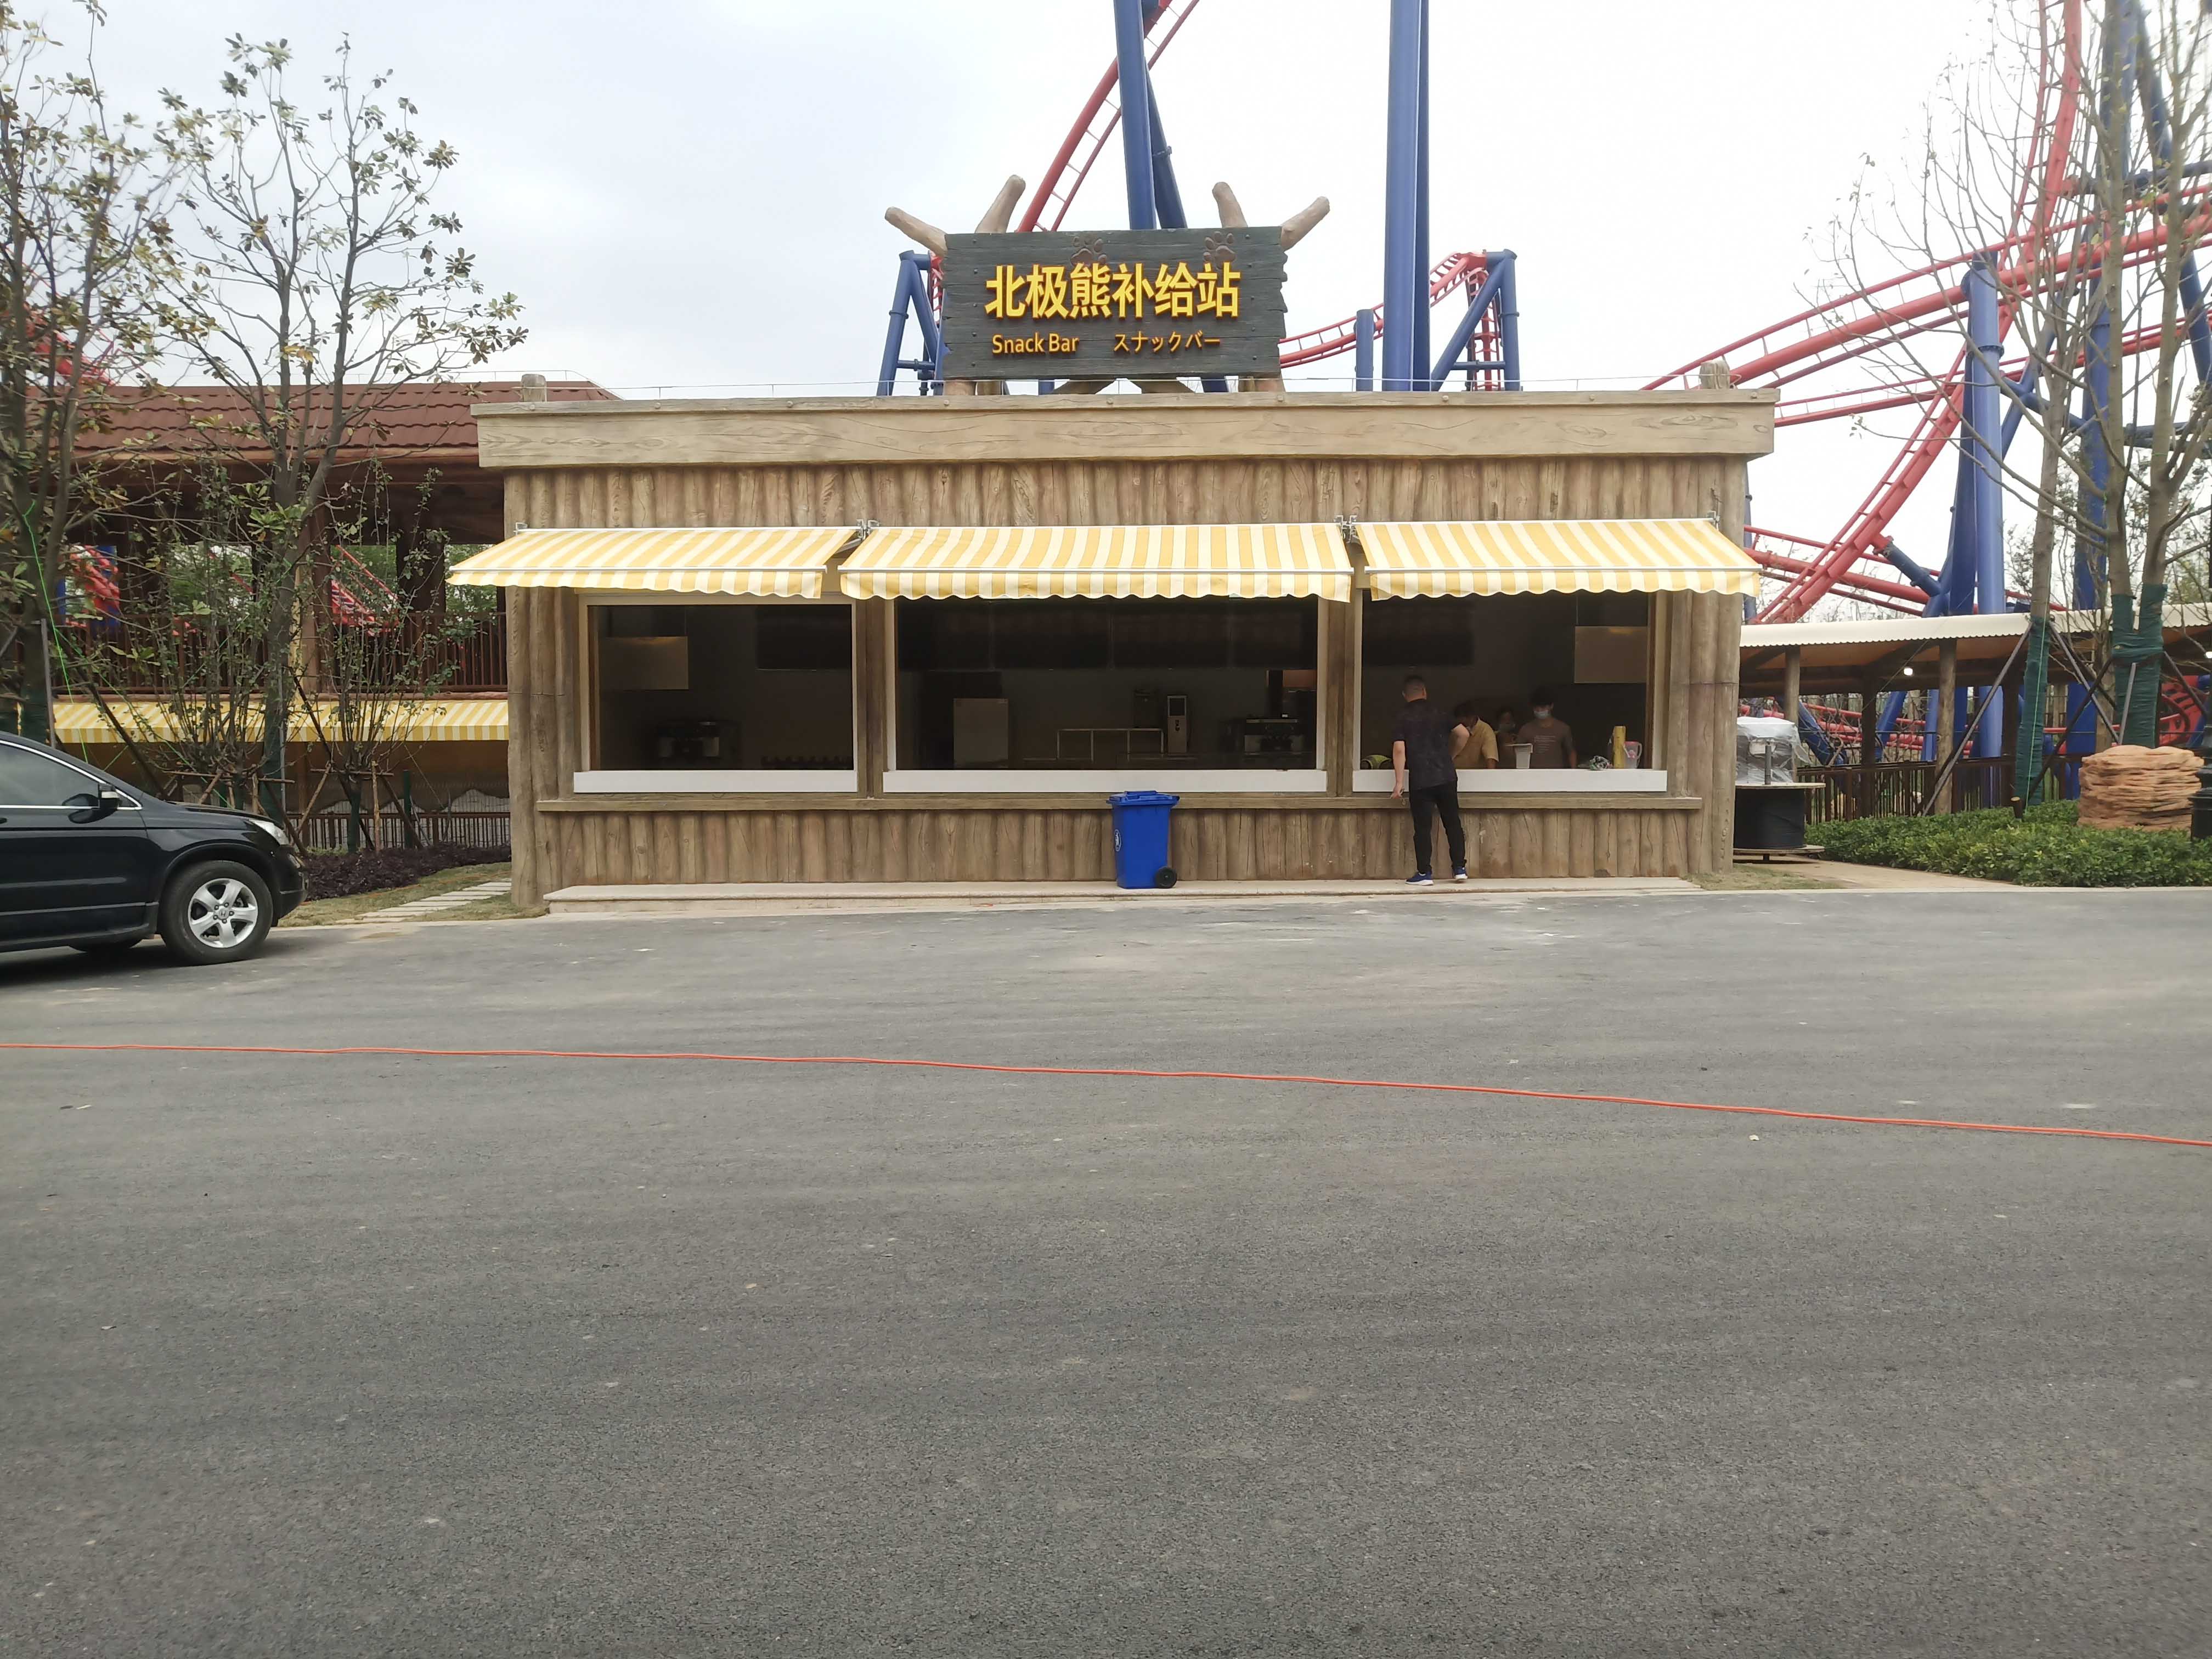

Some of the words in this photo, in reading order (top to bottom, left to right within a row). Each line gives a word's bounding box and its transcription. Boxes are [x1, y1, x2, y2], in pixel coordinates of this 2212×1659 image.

[985, 261, 1242, 319] 北极熊补给站
[992, 332, 1045, 354] Snack
[1048, 332, 1080, 353] Bar
[1114, 330, 1221, 353] スナックバー
